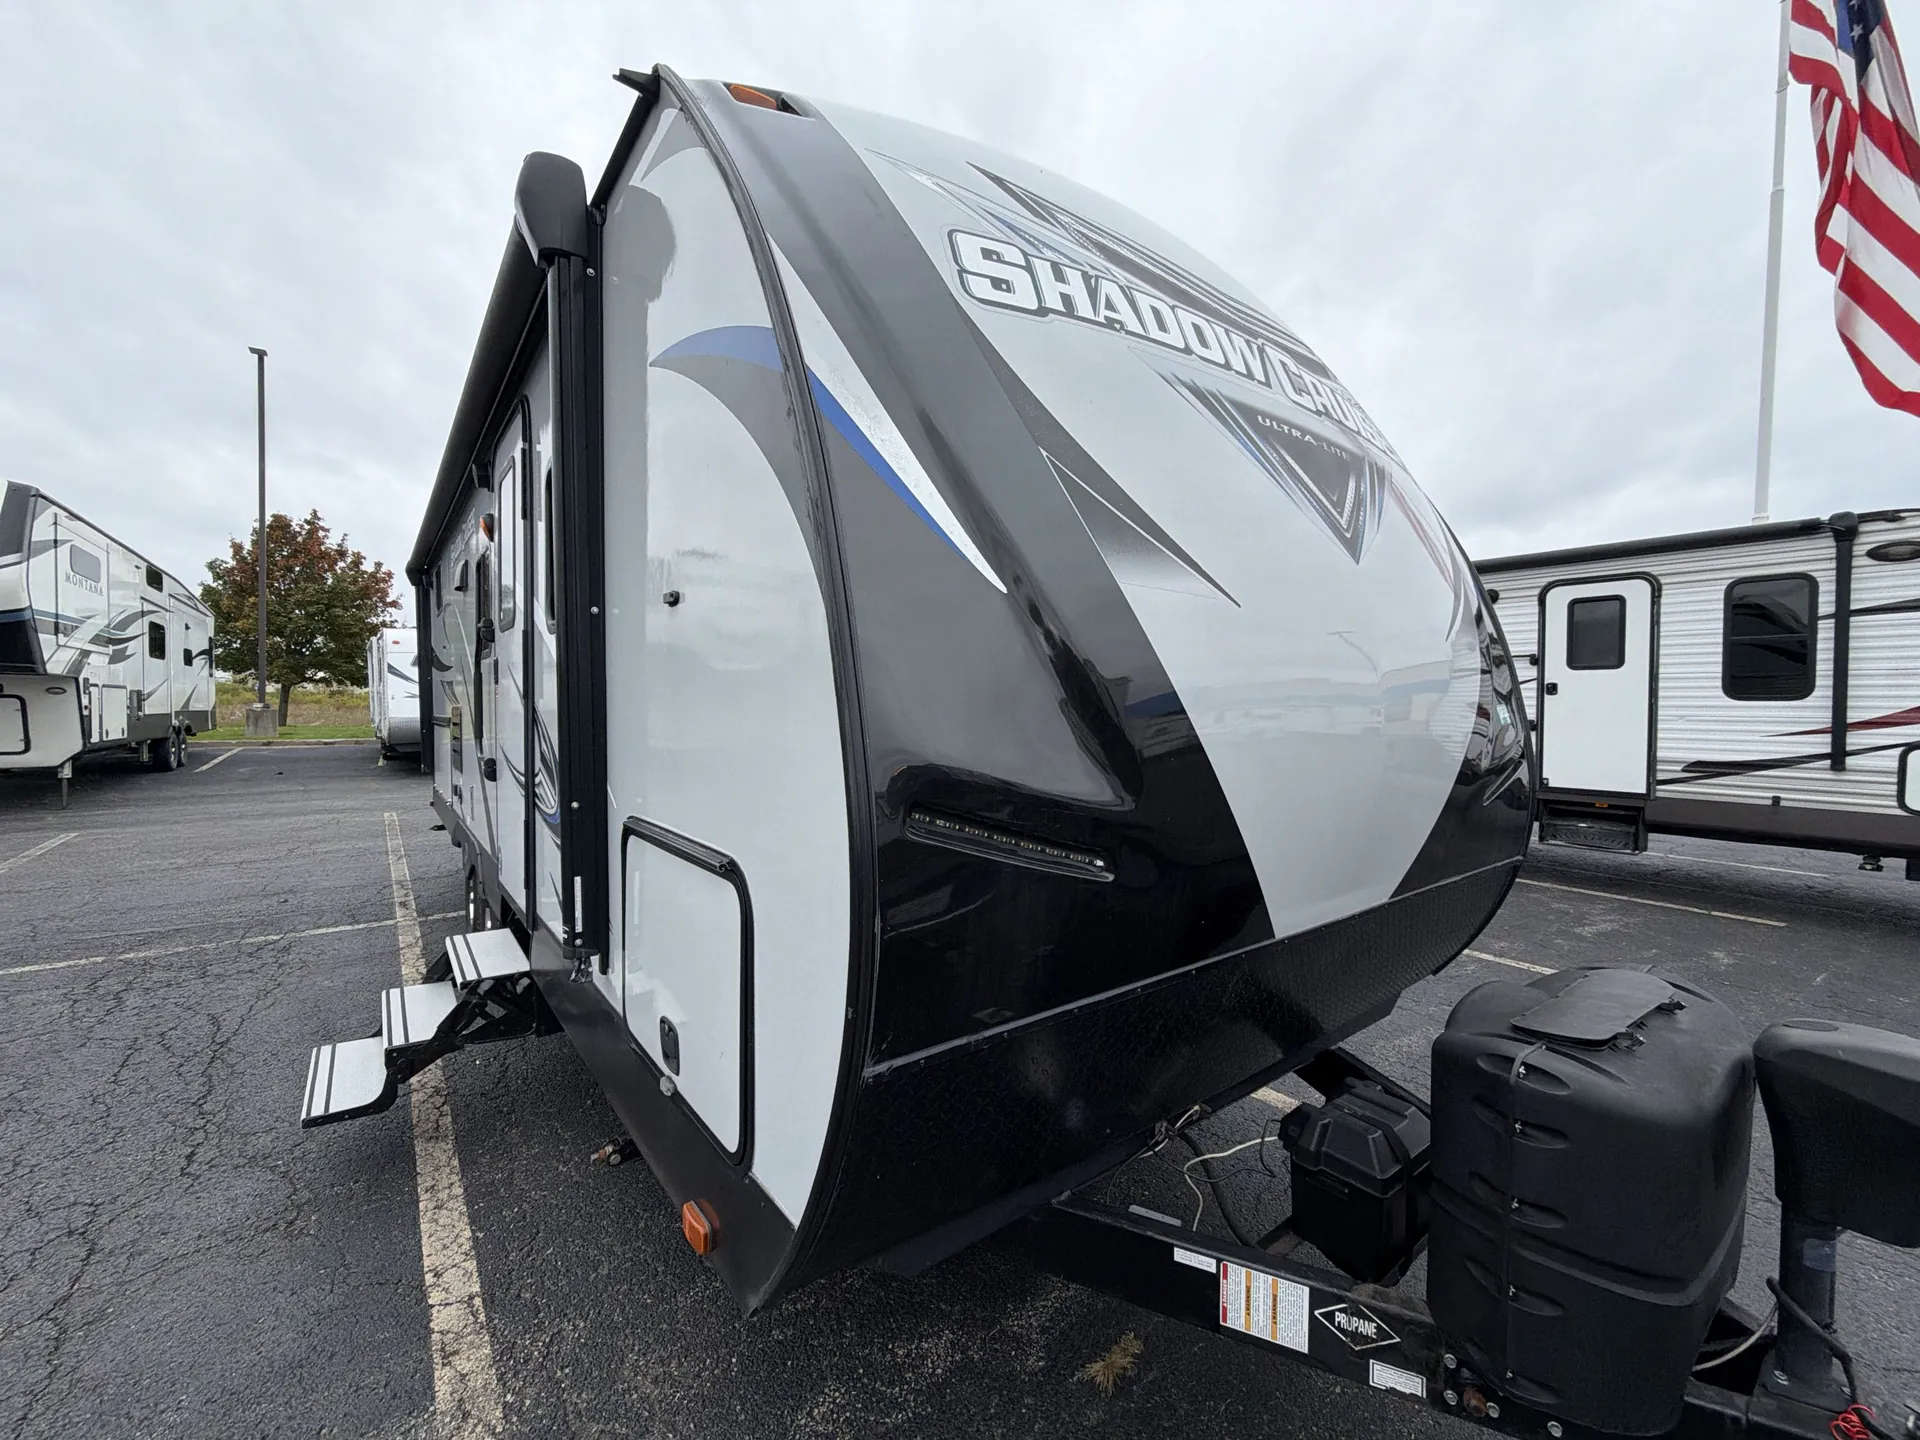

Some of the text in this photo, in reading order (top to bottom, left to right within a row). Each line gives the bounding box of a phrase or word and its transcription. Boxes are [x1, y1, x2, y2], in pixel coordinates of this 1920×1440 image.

[948, 230, 1269, 387] SHADOW
[1256, 415, 1352, 462] ULTRA-LITE
[65, 570, 104, 597] MONTANA
[1334, 1311, 1378, 1339] PROPANE
